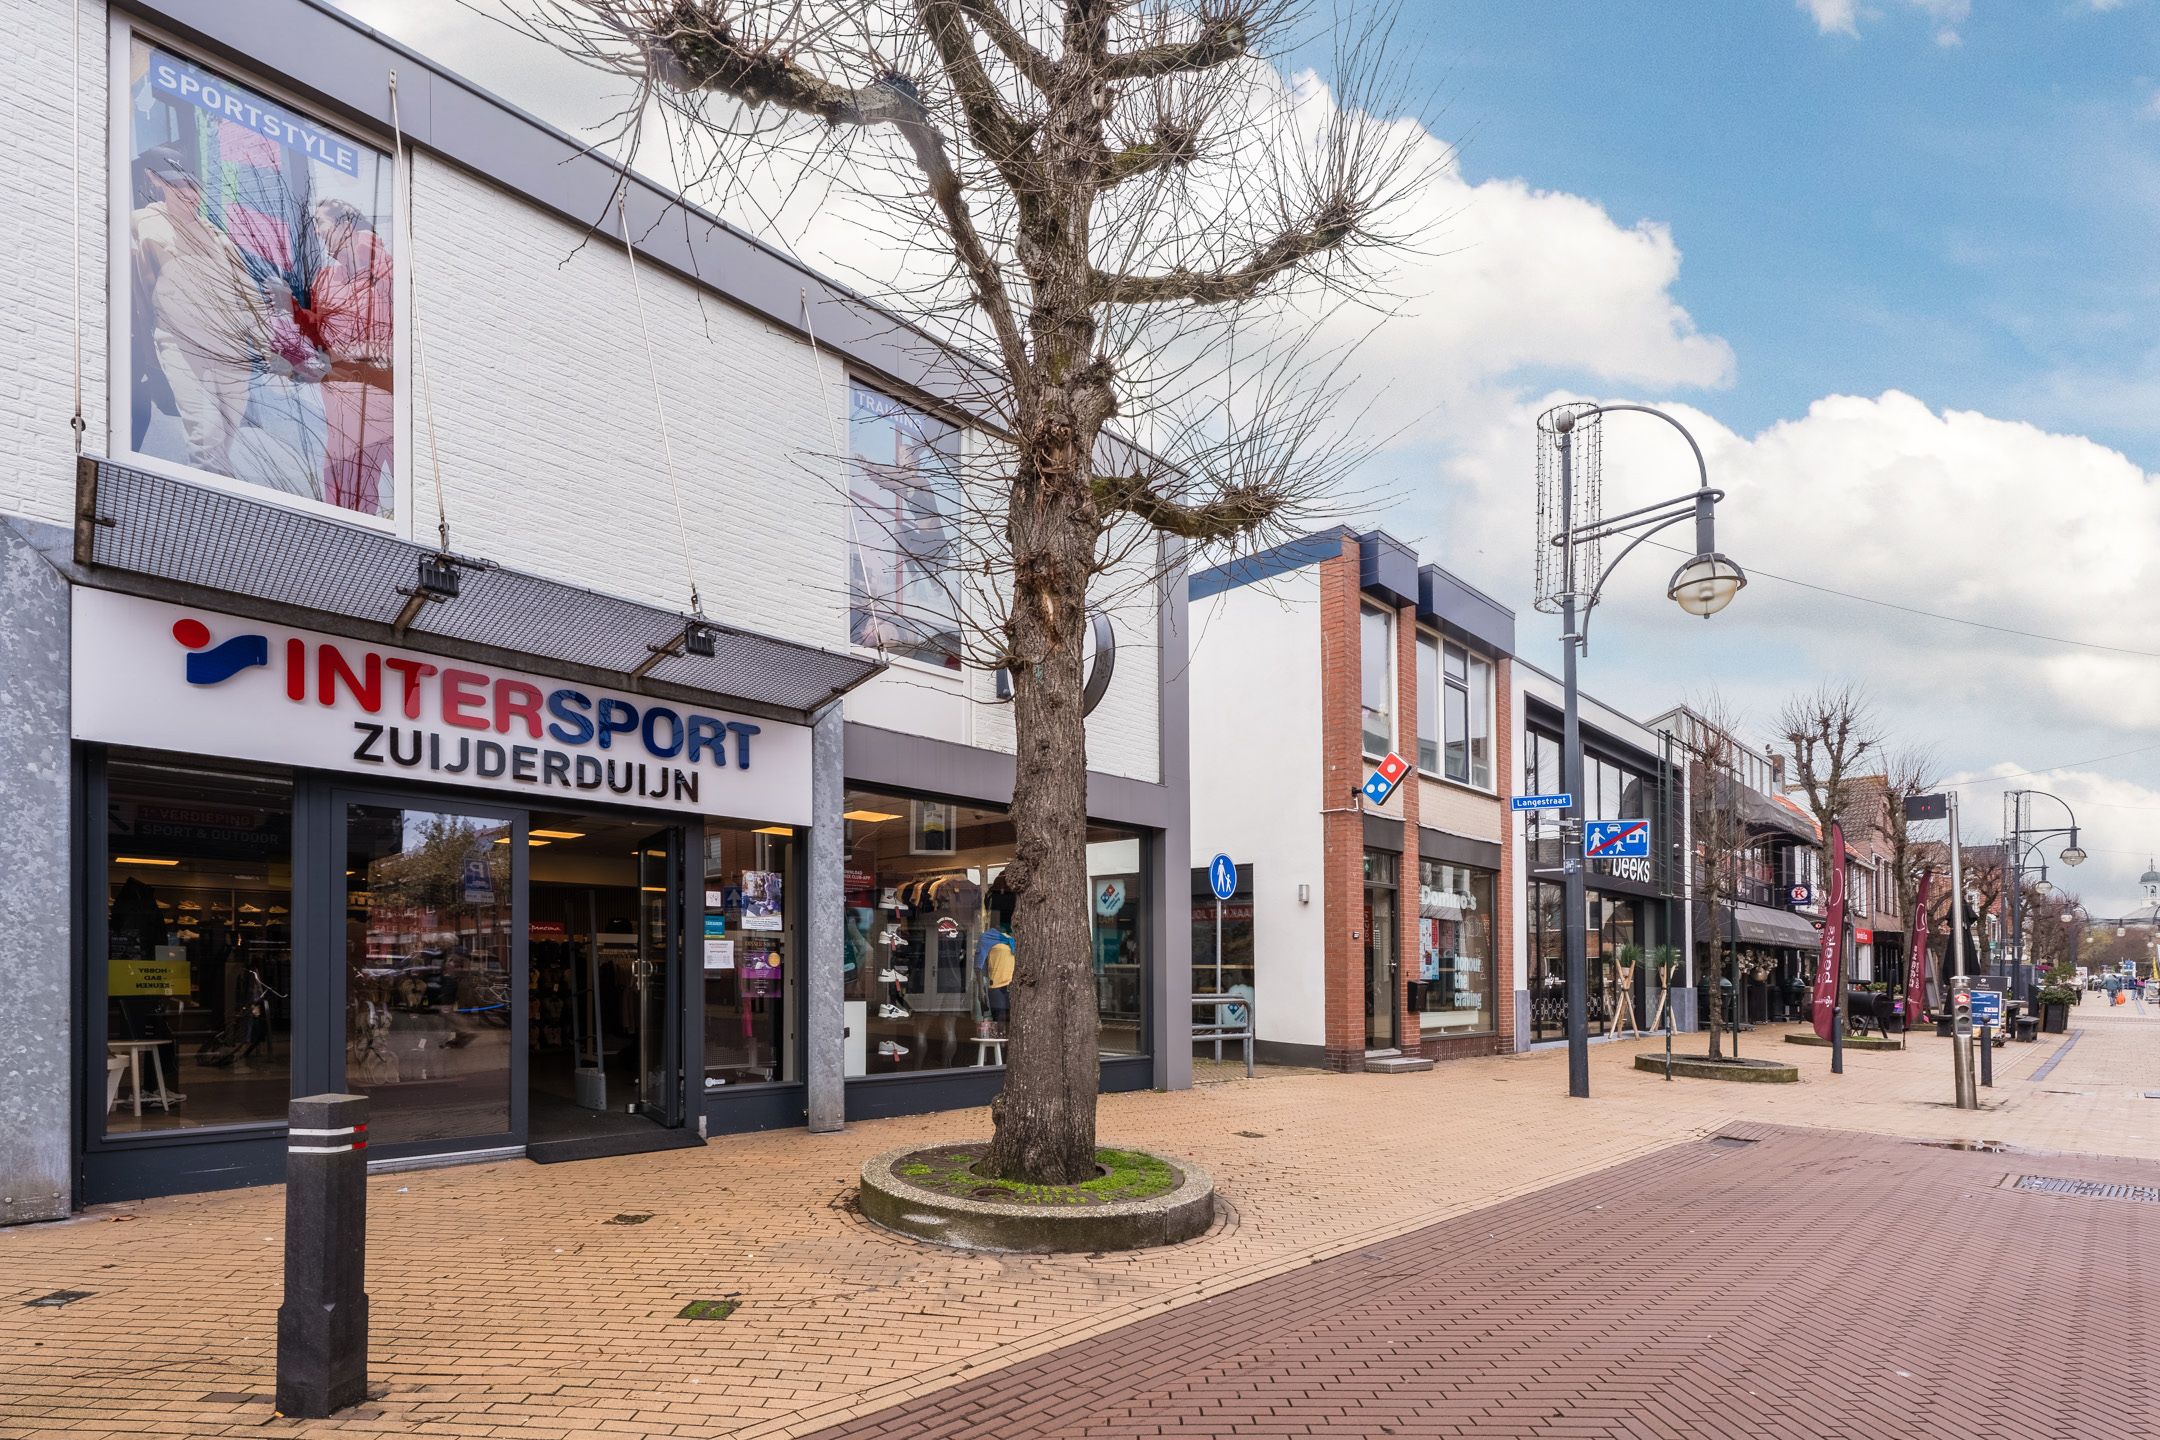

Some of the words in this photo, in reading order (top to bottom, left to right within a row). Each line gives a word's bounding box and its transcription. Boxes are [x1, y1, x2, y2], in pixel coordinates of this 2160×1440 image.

[158, 64, 353, 171] SPORTSTYLE
[287, 637, 761, 770] INTERSPORT
[353, 721, 699, 803] ZUIJDERDUIJN
[1516, 797, 1567, 807] Langestraat
[159, 808, 252, 826] VERDIEPING
[142, 824, 194, 838] SPORT
[196, 830, 207, 840] &
[211, 831, 280, 845] OUTDOOR
[1421, 885, 1477, 911] Domino's
[1454, 953, 1481, 973] honour
[1454, 972, 1469, 989] the
[1454, 991, 1482, 1010] craving
